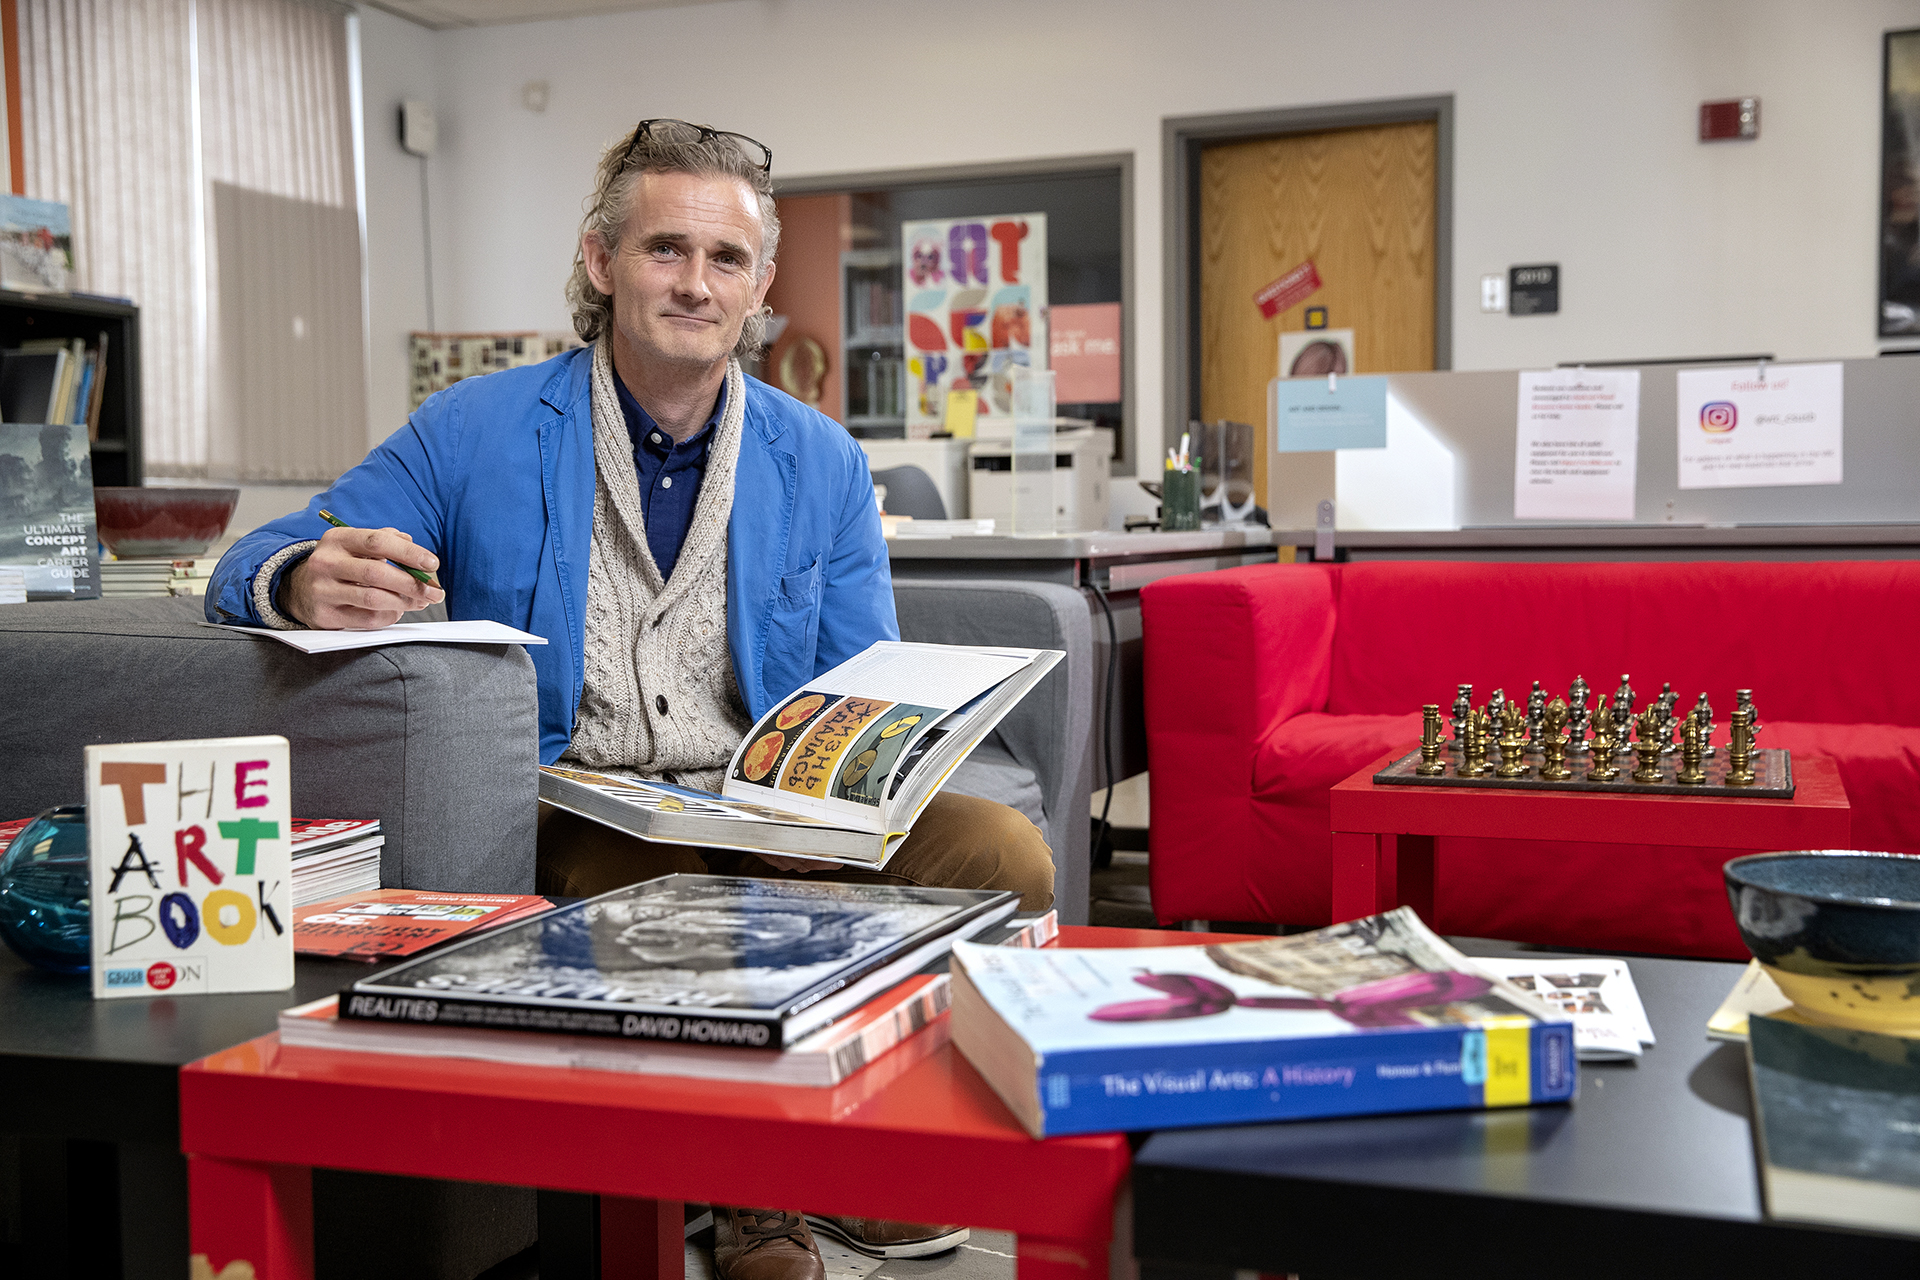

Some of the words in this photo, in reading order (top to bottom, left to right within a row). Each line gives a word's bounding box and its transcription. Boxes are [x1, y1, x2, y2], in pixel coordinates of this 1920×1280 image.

[1051, 339, 1080, 357] ask
[59, 513, 85, 523] THE
[23, 524, 86, 535] ULTIMATE
[25, 535, 87, 546] CONCEPT
[38, 557, 89, 567] CAREER
[61, 546, 88, 556] ART
[50, 567, 90, 579] GUIDE
[806, 703, 880, 790] ЖИЗНЬ
[101, 760, 270, 826] THE
[108, 817, 280, 894] ART
[105, 880, 284, 957] BOOK
[350, 996, 438, 1022] REALITIES
[622, 1014, 681, 1039] DAVID
[681, 1018, 770, 1046] HOWARD
[1102, 1073, 1142, 1097] The
[1143, 1069, 1207, 1095] Visual
[1261, 1066, 1280, 1089] A
[1281, 1064, 1357, 1089] History
